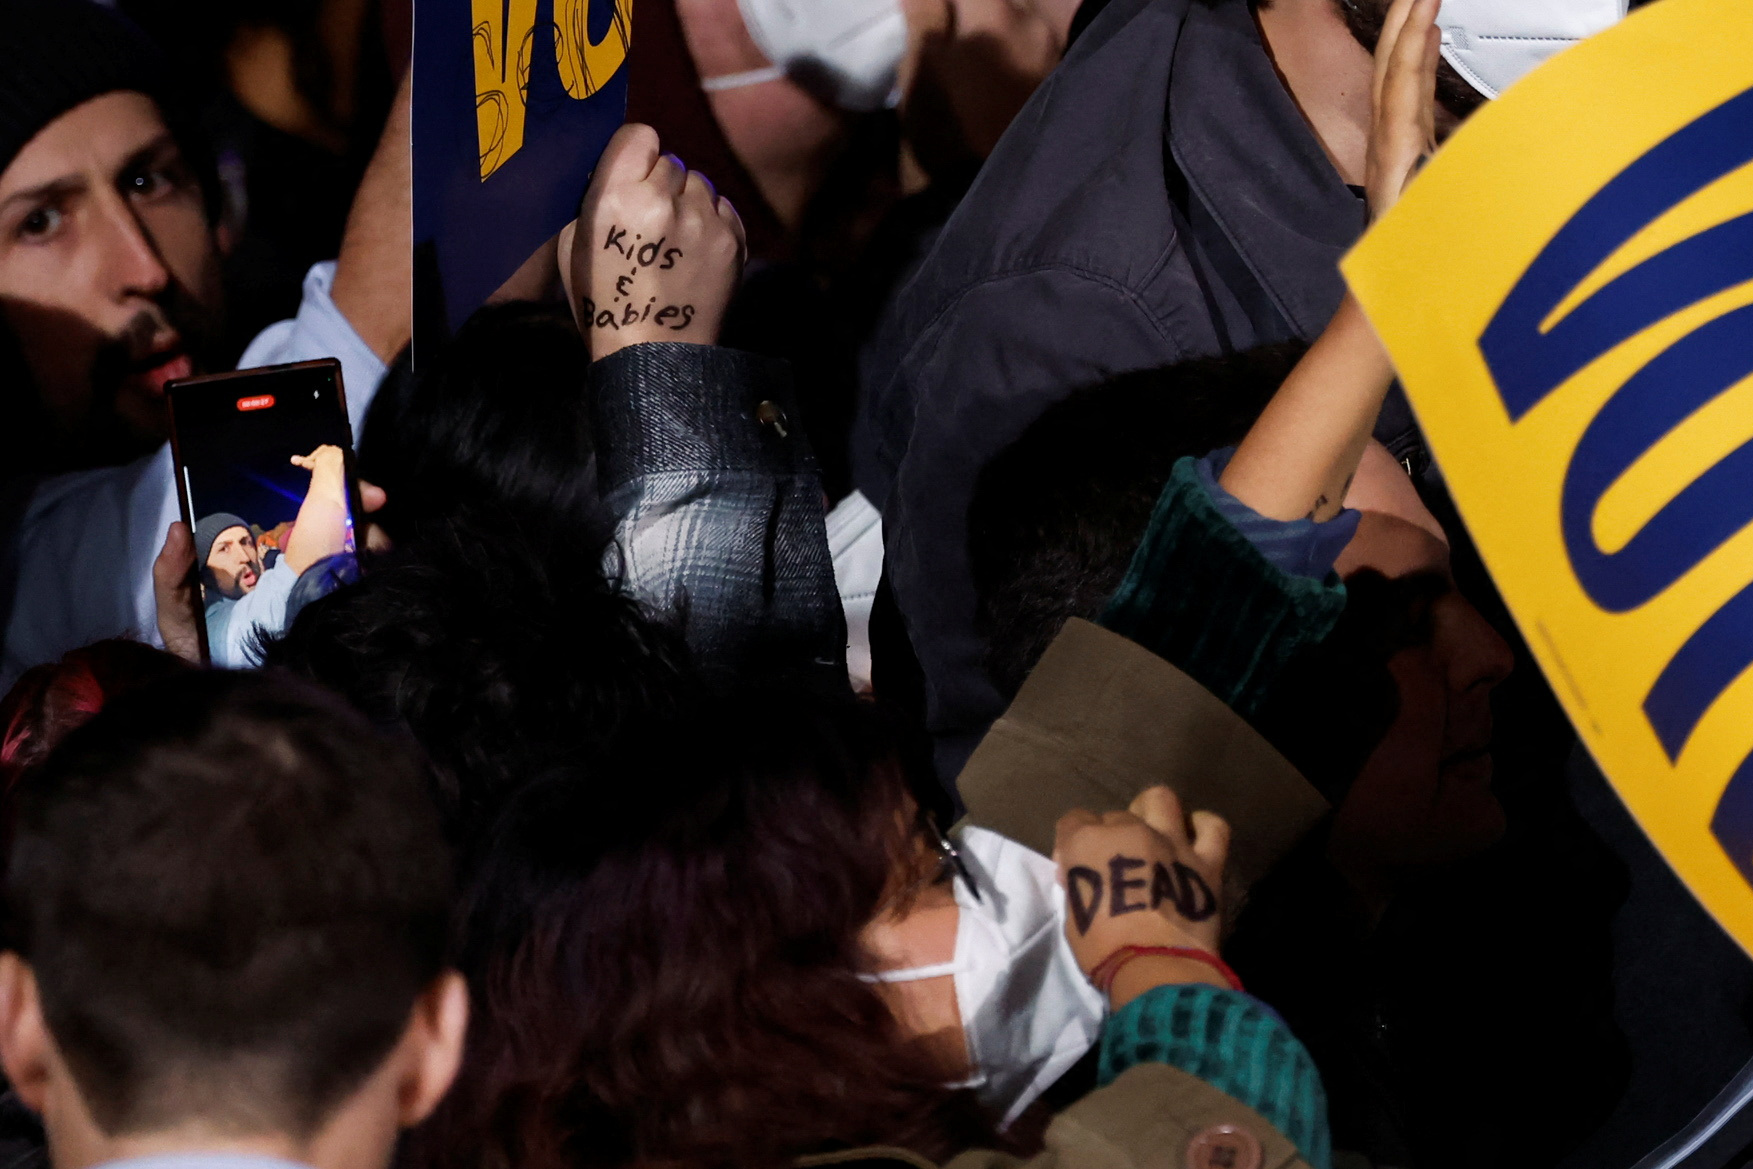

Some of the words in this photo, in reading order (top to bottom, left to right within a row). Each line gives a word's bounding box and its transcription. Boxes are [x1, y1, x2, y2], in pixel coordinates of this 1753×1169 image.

[603, 225, 683, 269] Kids
[583, 296, 695, 330] Babies
[1067, 854, 1217, 936] DEAD
